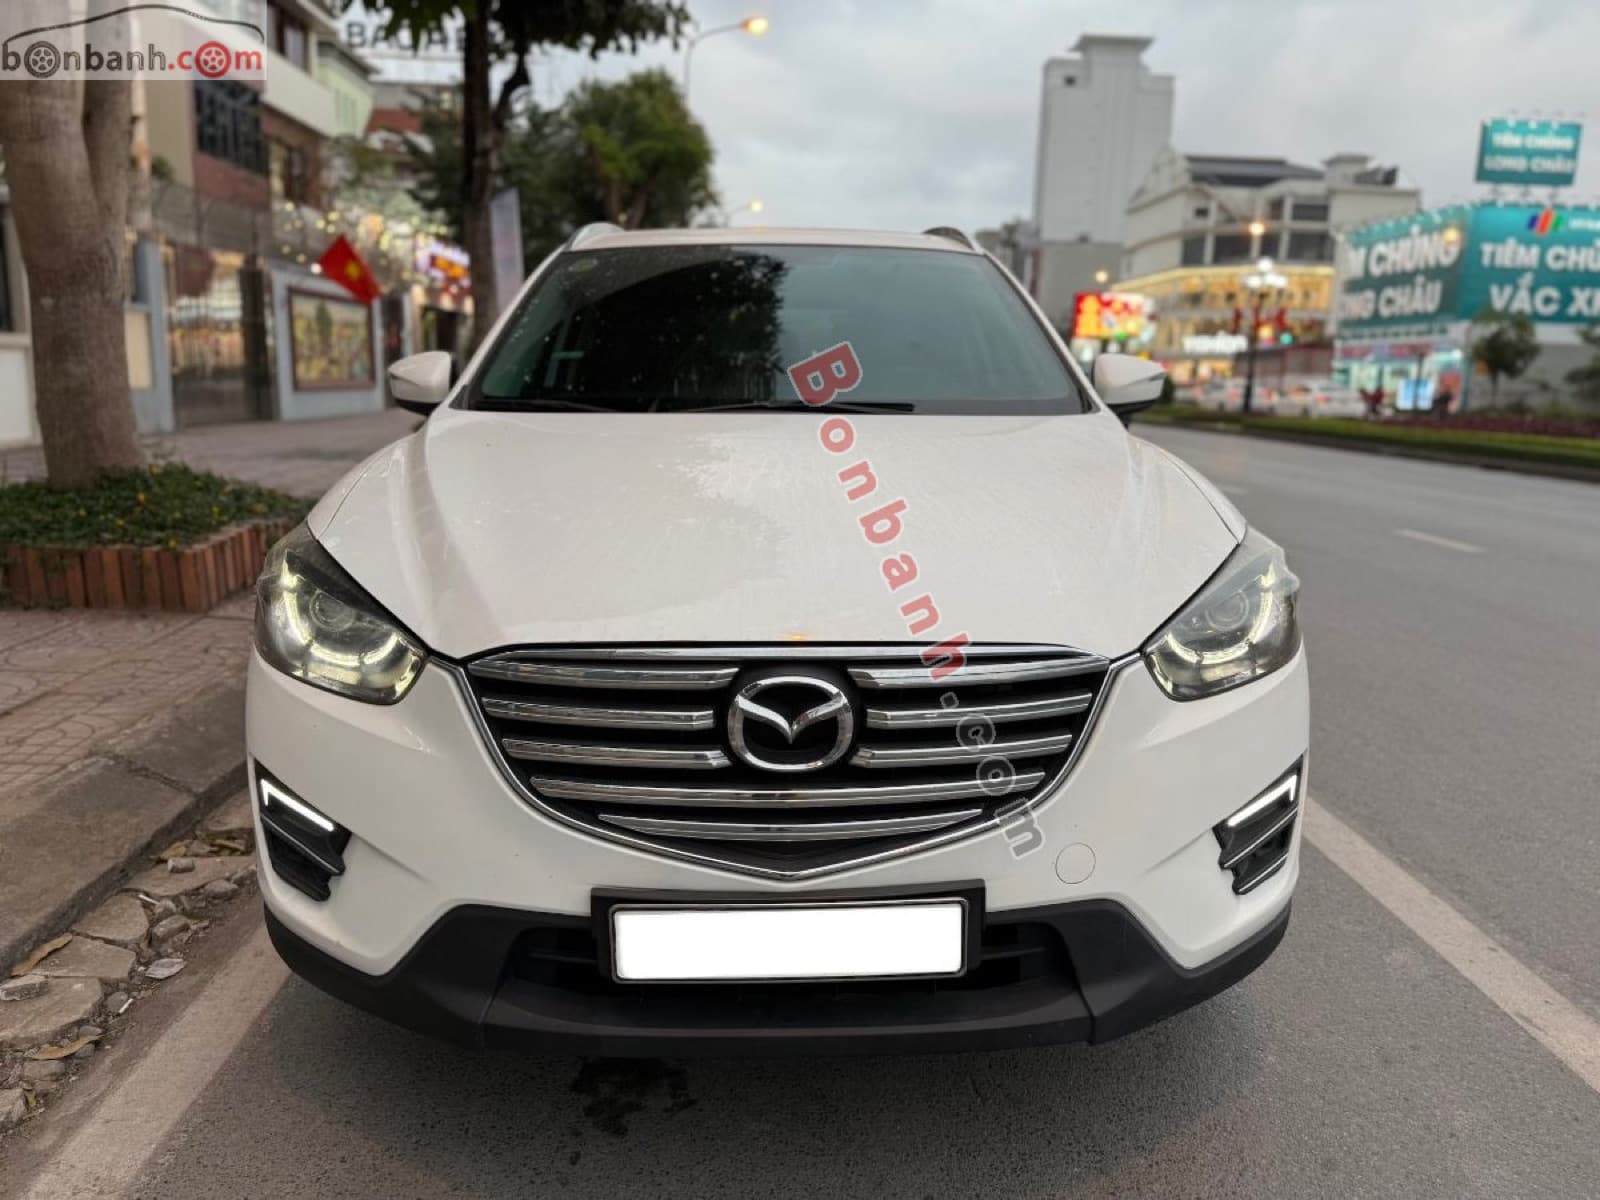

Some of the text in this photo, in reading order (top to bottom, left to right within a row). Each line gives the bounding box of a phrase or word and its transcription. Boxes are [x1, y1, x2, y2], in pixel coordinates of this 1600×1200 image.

[1481, 235, 1540, 269] TIÊM
[1377, 273, 1443, 318] CHÂU
[1488, 271, 1562, 316] VẮC
